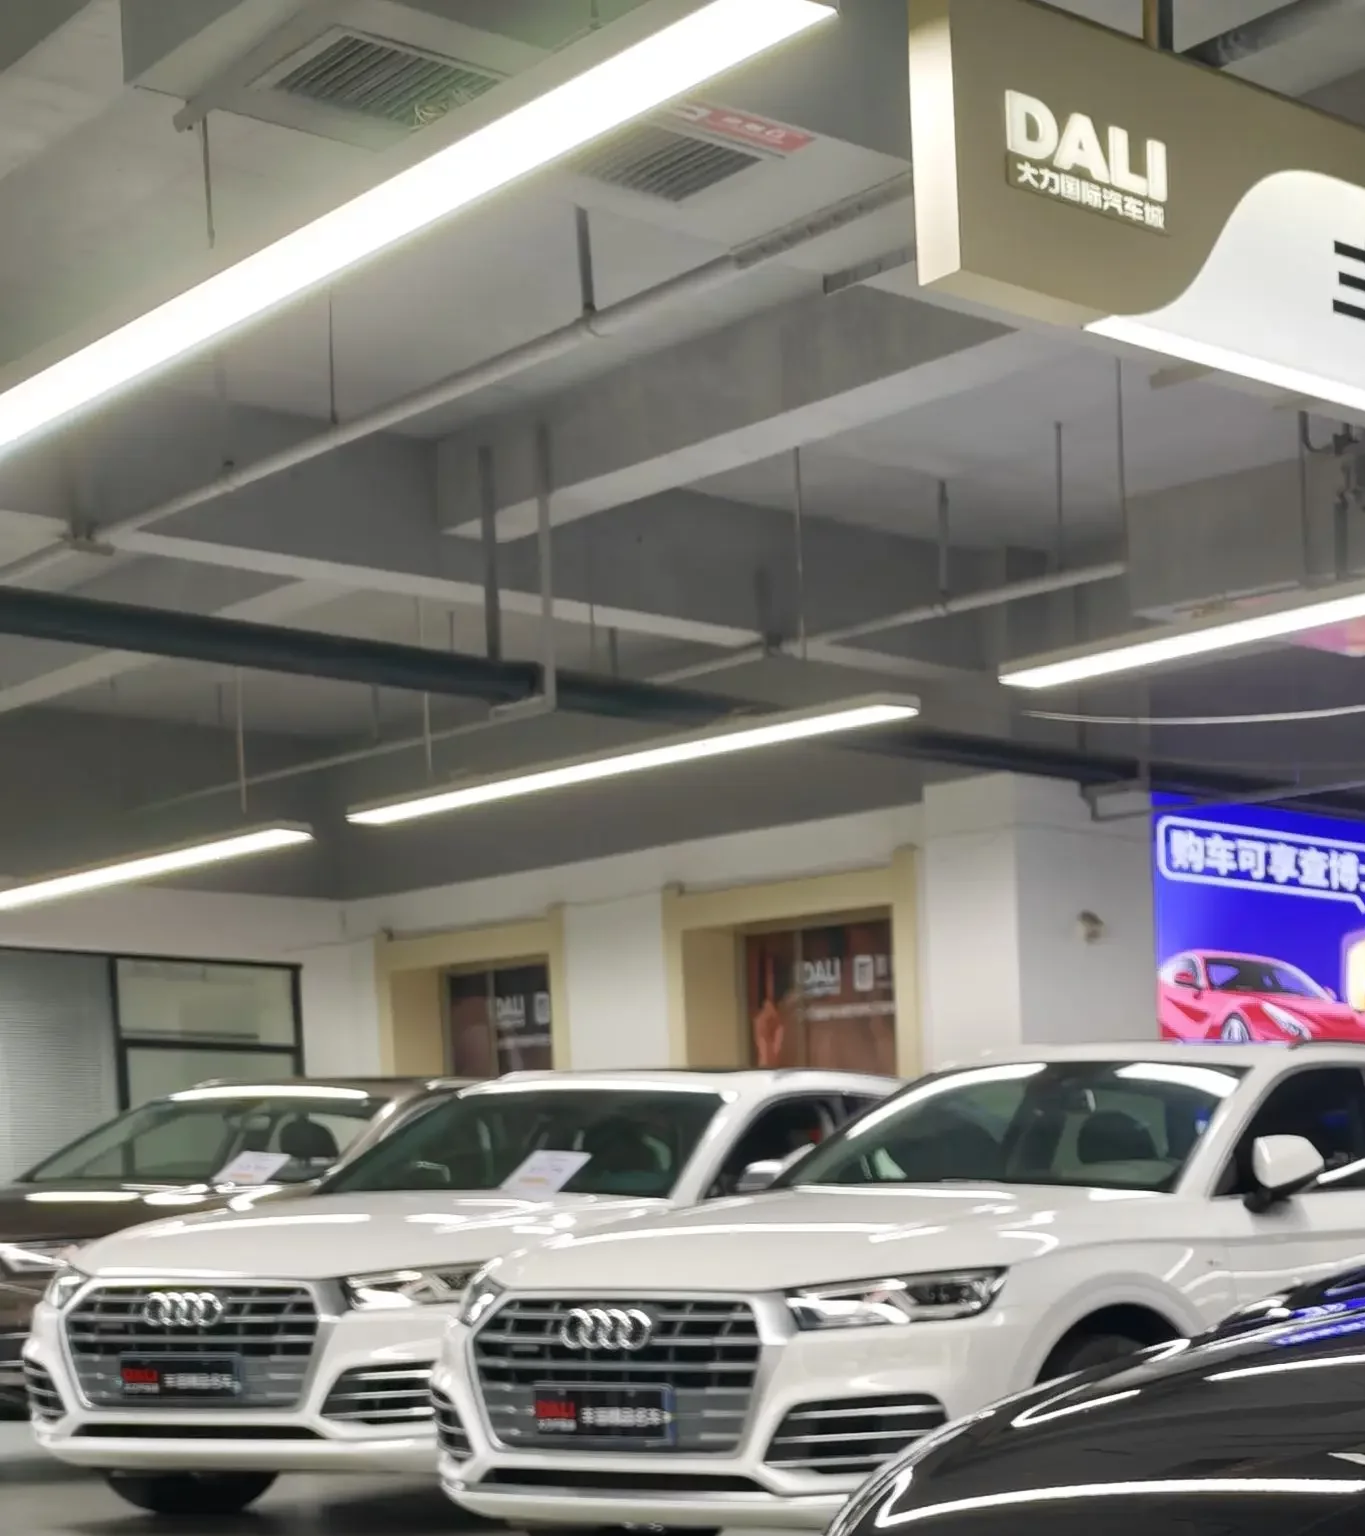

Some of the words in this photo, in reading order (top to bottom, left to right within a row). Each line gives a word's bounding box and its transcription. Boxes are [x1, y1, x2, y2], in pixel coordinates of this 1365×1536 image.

[1005, 89, 1167, 203] DALI
[1016, 161, 1165, 229] 大力国际汽车城
